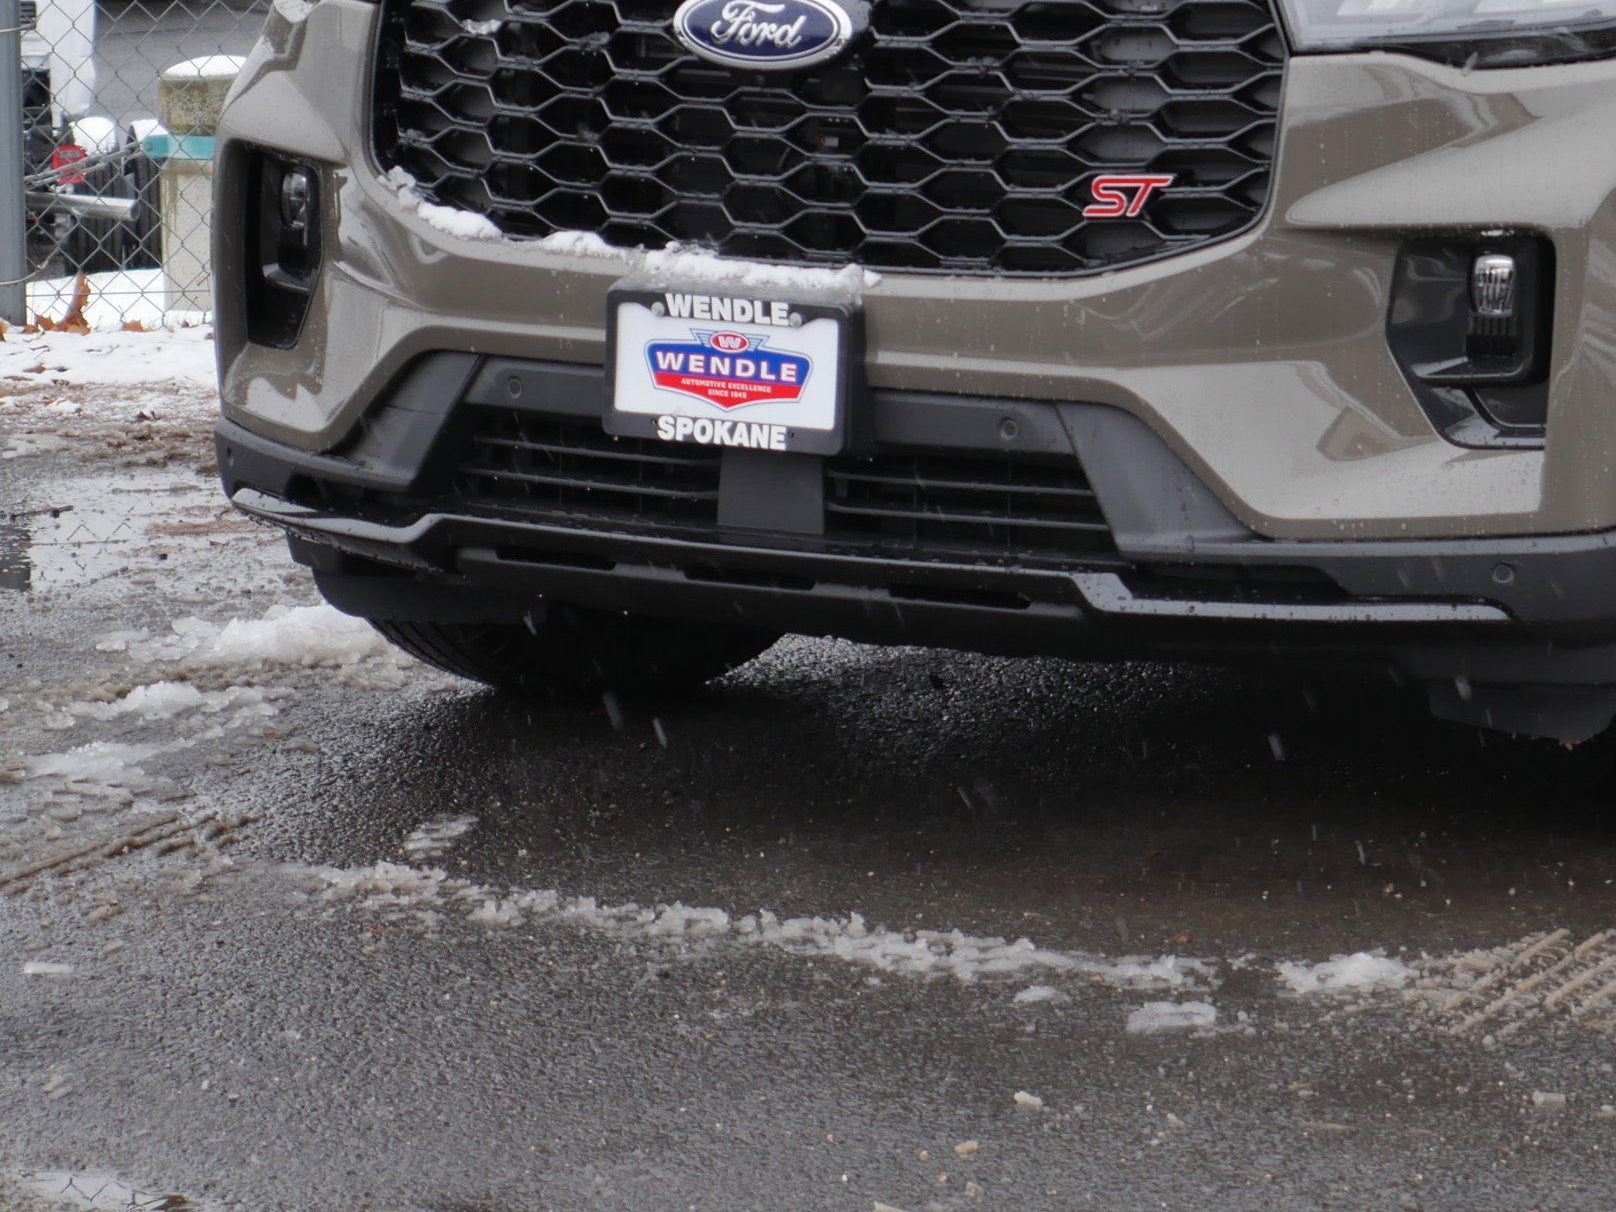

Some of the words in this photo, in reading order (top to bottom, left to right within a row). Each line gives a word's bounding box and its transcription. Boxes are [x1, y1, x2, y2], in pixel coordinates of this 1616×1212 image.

[1082, 174, 1176, 217] ST
[665, 293, 790, 327] WENDLE
[655, 350, 798, 382] WENDLE
[681, 377, 727, 389] AUTOMOTIVE
[727, 381, 772, 394] EXCELLENCE
[707, 388, 730, 398] SINCE
[657, 414, 787, 452] SPOKANE
